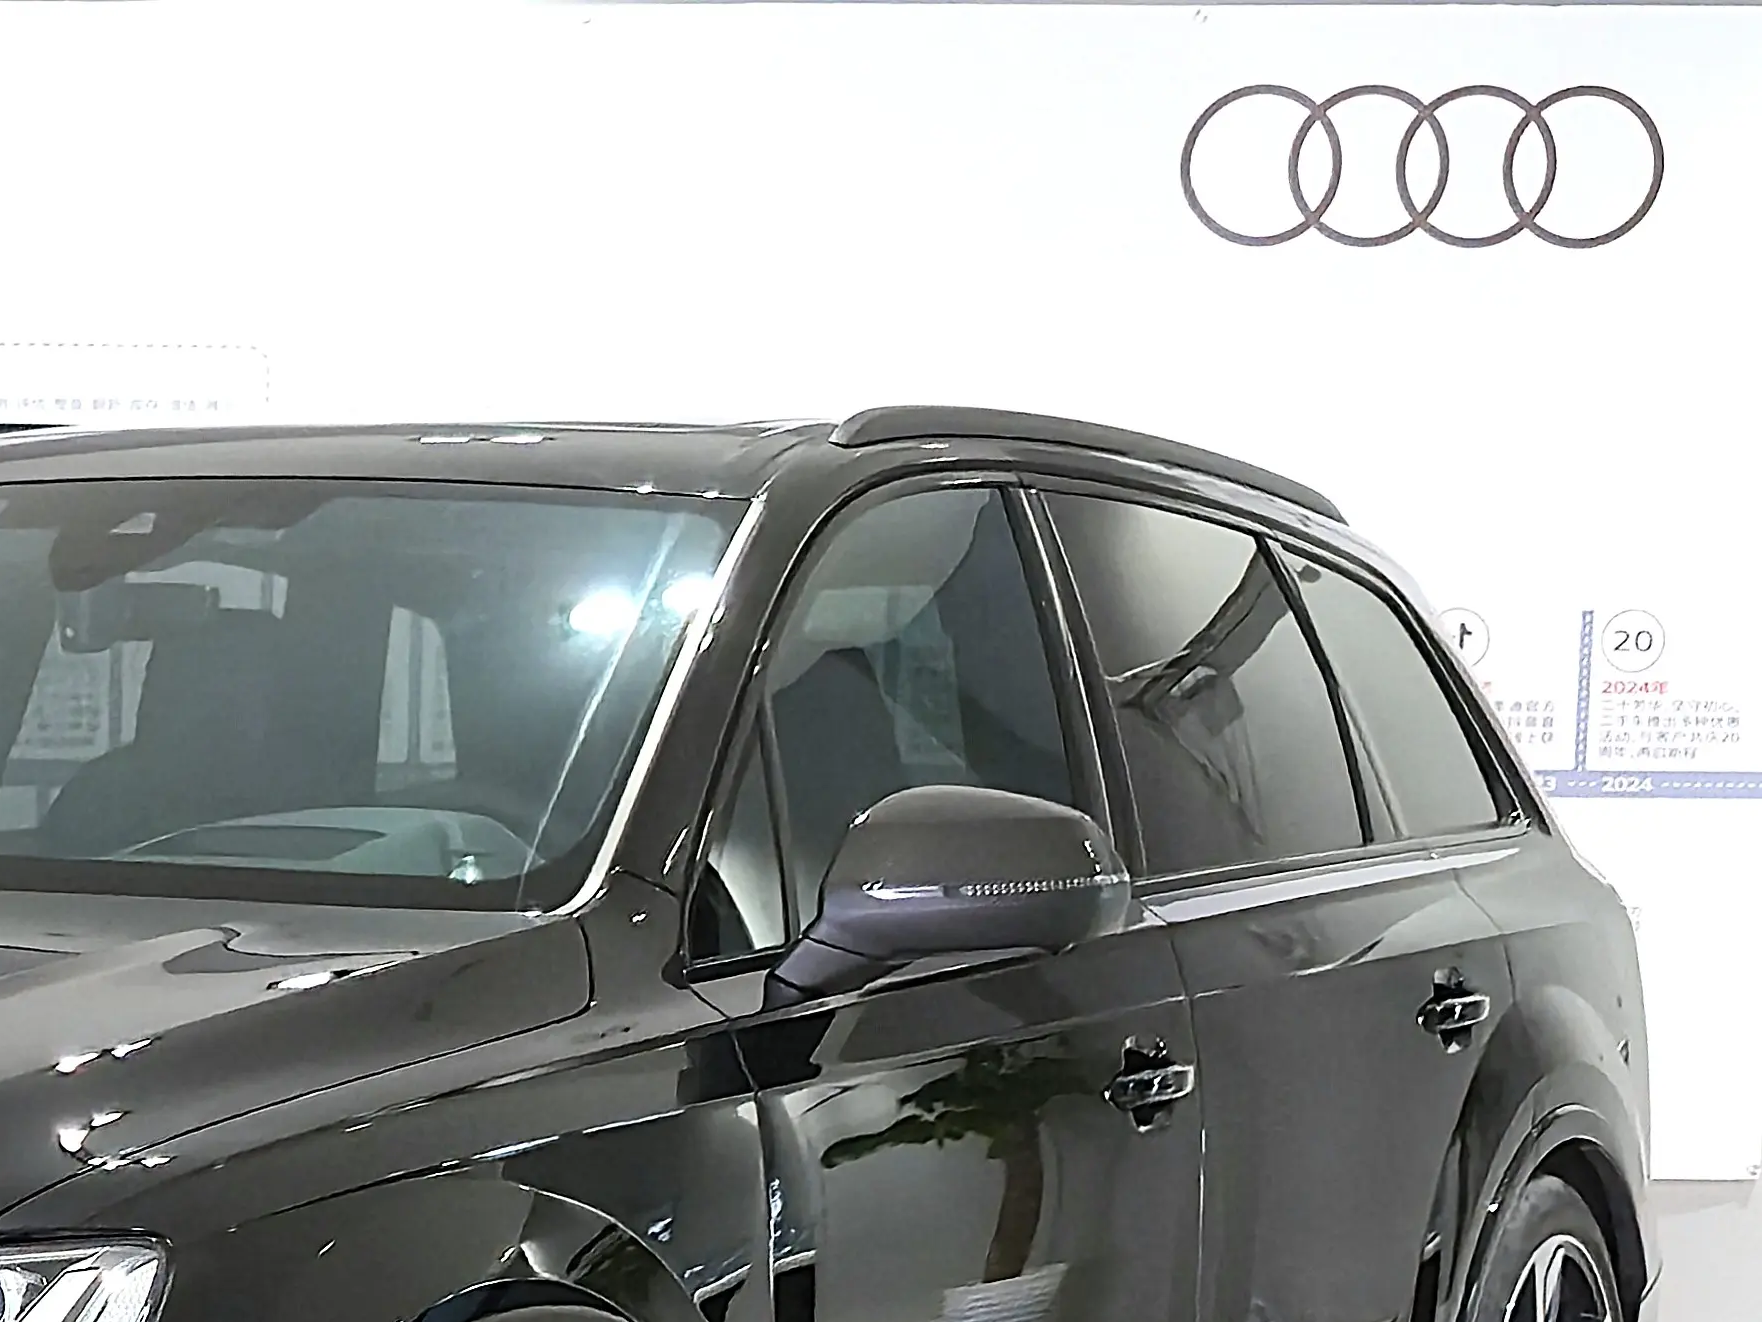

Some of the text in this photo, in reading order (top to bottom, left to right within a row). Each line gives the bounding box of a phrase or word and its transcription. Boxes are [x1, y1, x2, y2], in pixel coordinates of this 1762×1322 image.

[1613, 629, 1653, 652] 20
[1602, 680, 1669, 694] 2024年
[1602, 776, 1654, 793] 2024
